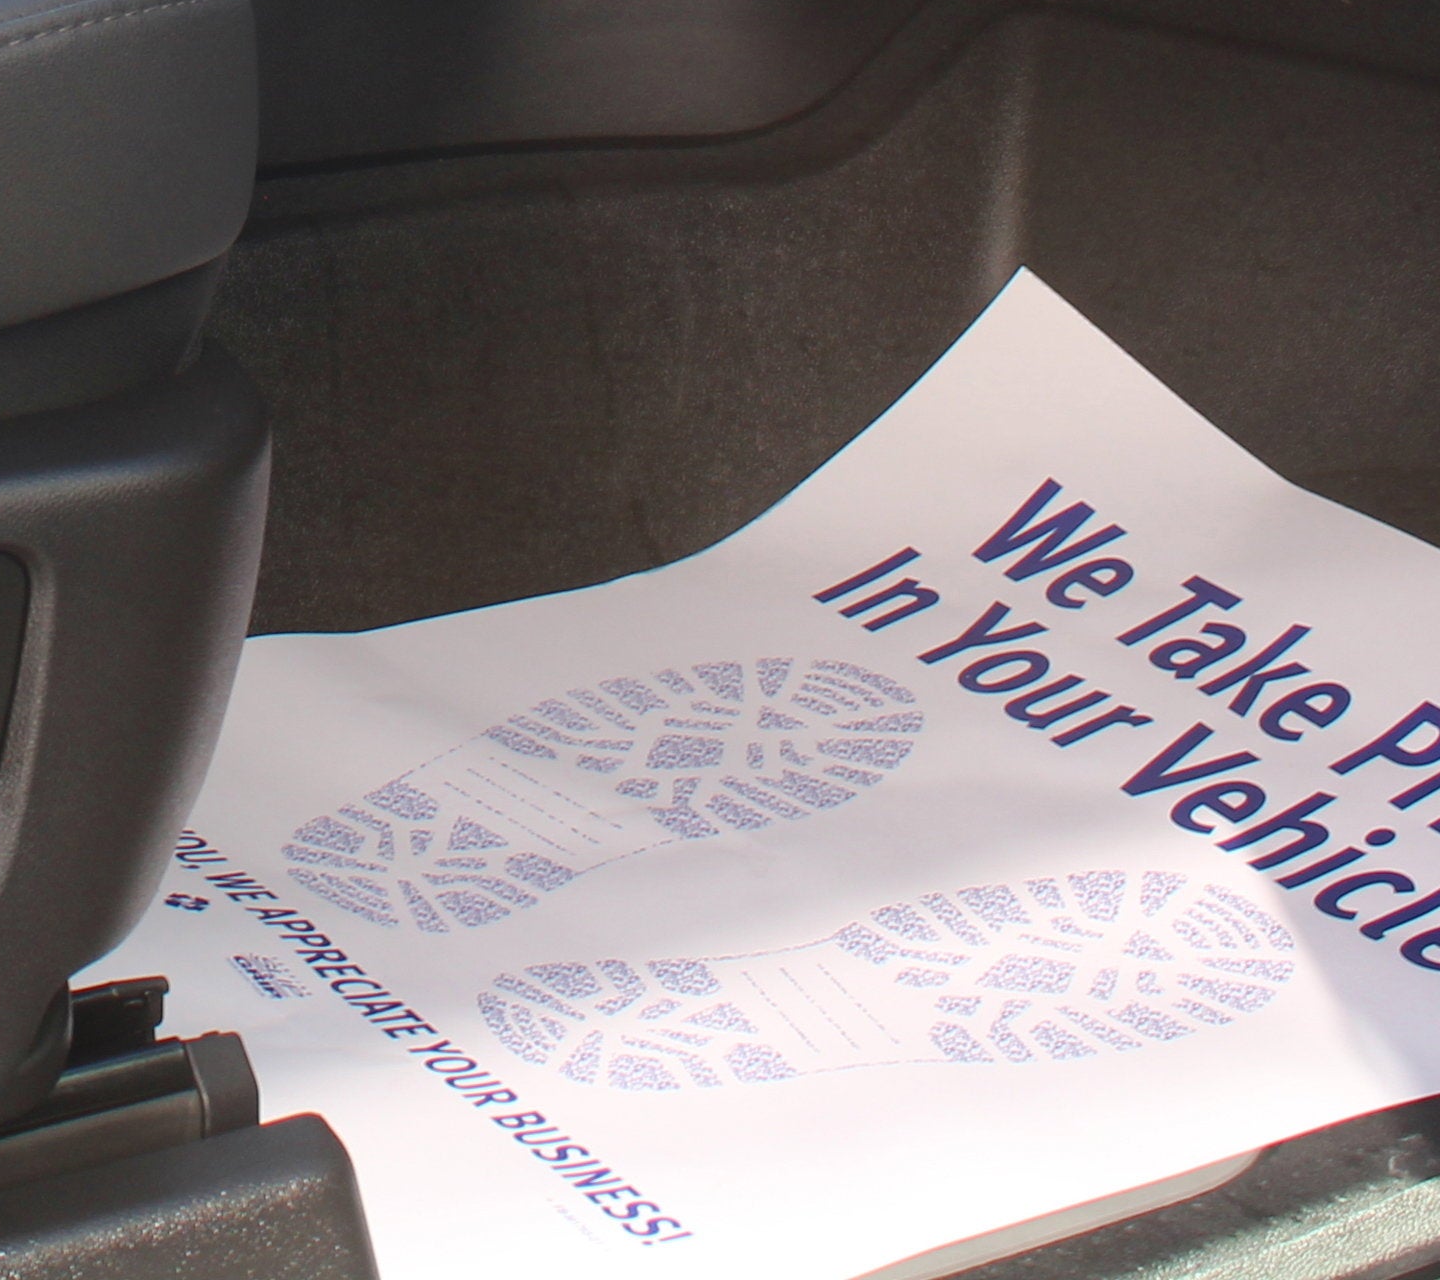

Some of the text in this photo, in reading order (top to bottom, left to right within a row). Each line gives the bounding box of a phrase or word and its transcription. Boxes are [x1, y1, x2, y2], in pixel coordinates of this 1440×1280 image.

[812, 546, 941, 632] In
[915, 600, 1154, 748] Your
[971, 476, 1133, 610] We
[1114, 574, 1352, 743] Take
[174, 829, 228, 869] OU,
[205, 872, 279, 902] WE
[245, 907, 438, 1039] APPRECIATE
[407, 1040, 518, 1108] YOUR
[490, 1110, 694, 1246] BUSINESS!
